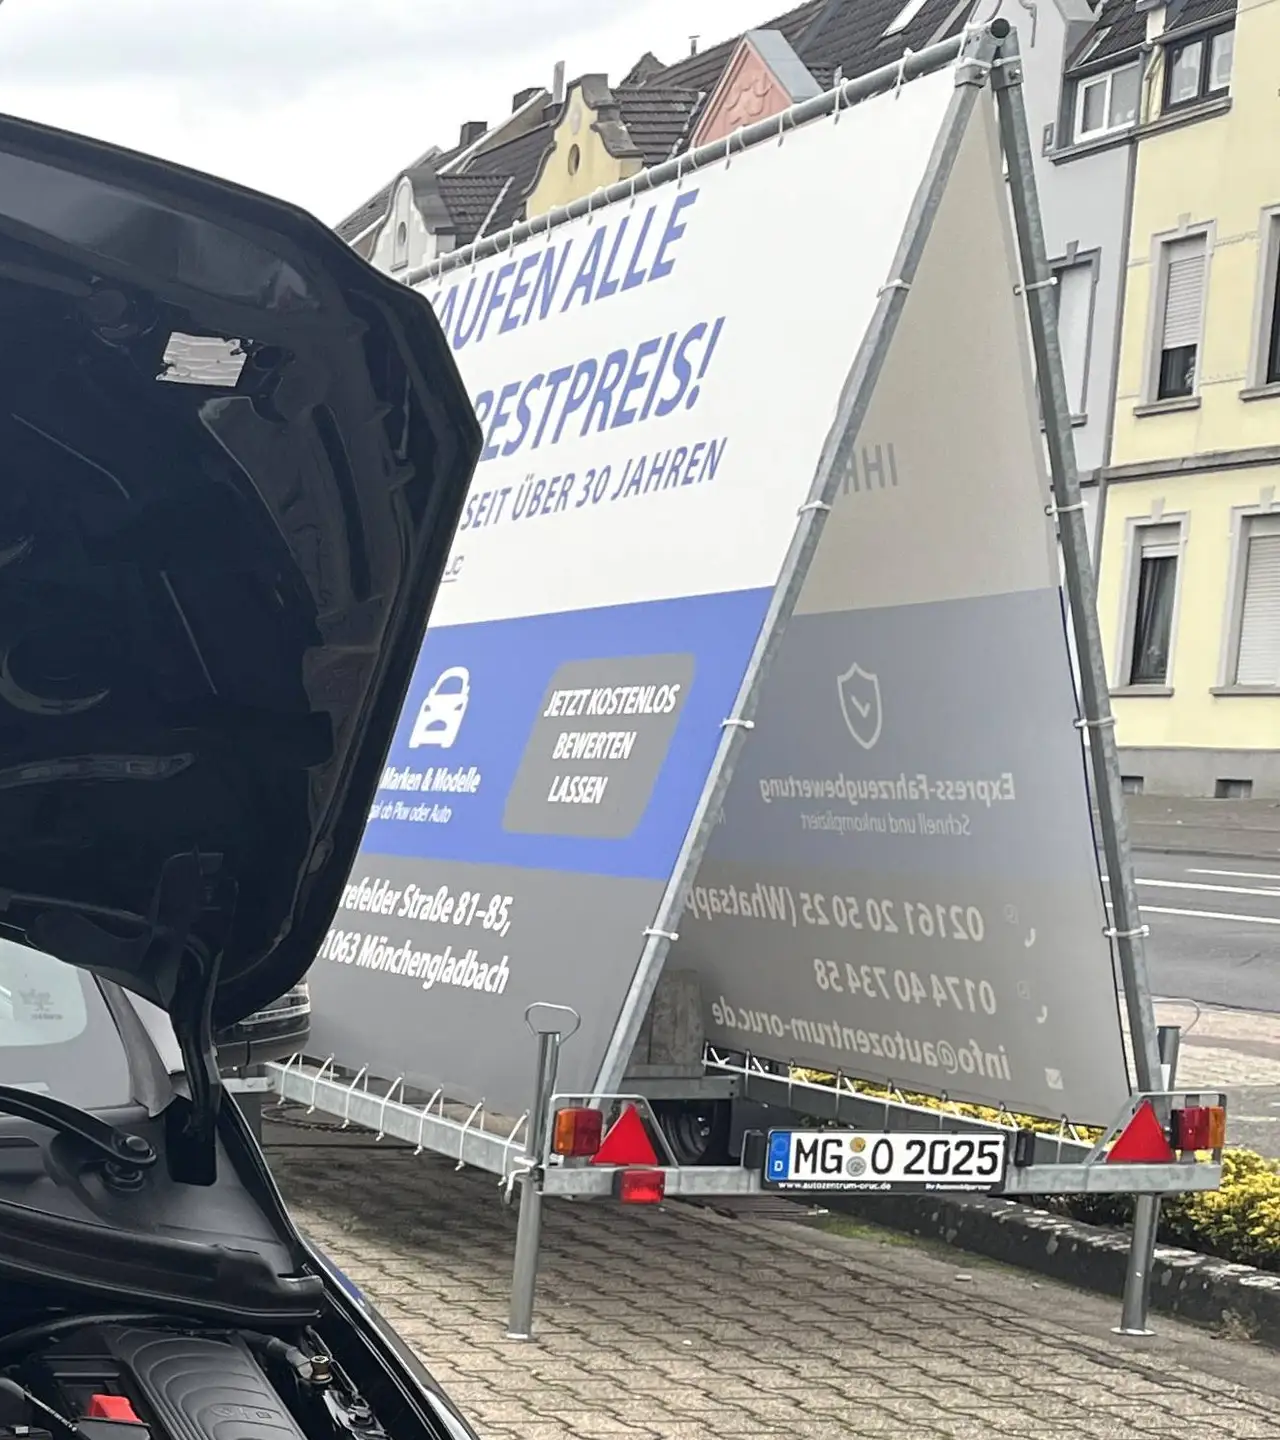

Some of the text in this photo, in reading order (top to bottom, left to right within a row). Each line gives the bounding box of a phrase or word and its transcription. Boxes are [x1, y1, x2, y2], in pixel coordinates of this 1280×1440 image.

[431, 188, 700, 350] AUFEN ALLE
[460, 437, 728, 531] SEIT ÜBER 30 JAHREN
[543, 684, 681, 717] JETZT KOSTENLOS
[552, 731, 637, 759] BEWERTEN
[380, 766, 423, 791] Marken
[431, 766, 481, 793] Modelle
[547, 776, 609, 804] LASSEN
[339, 876, 402, 915] refelder
[397, 883, 454, 923] Straße
[317, 929, 510, 994] 1063 Mönchengladbach
[774, 1161, 784, 1171] D
[794, 1138, 1000, 1175] MG O 2025
